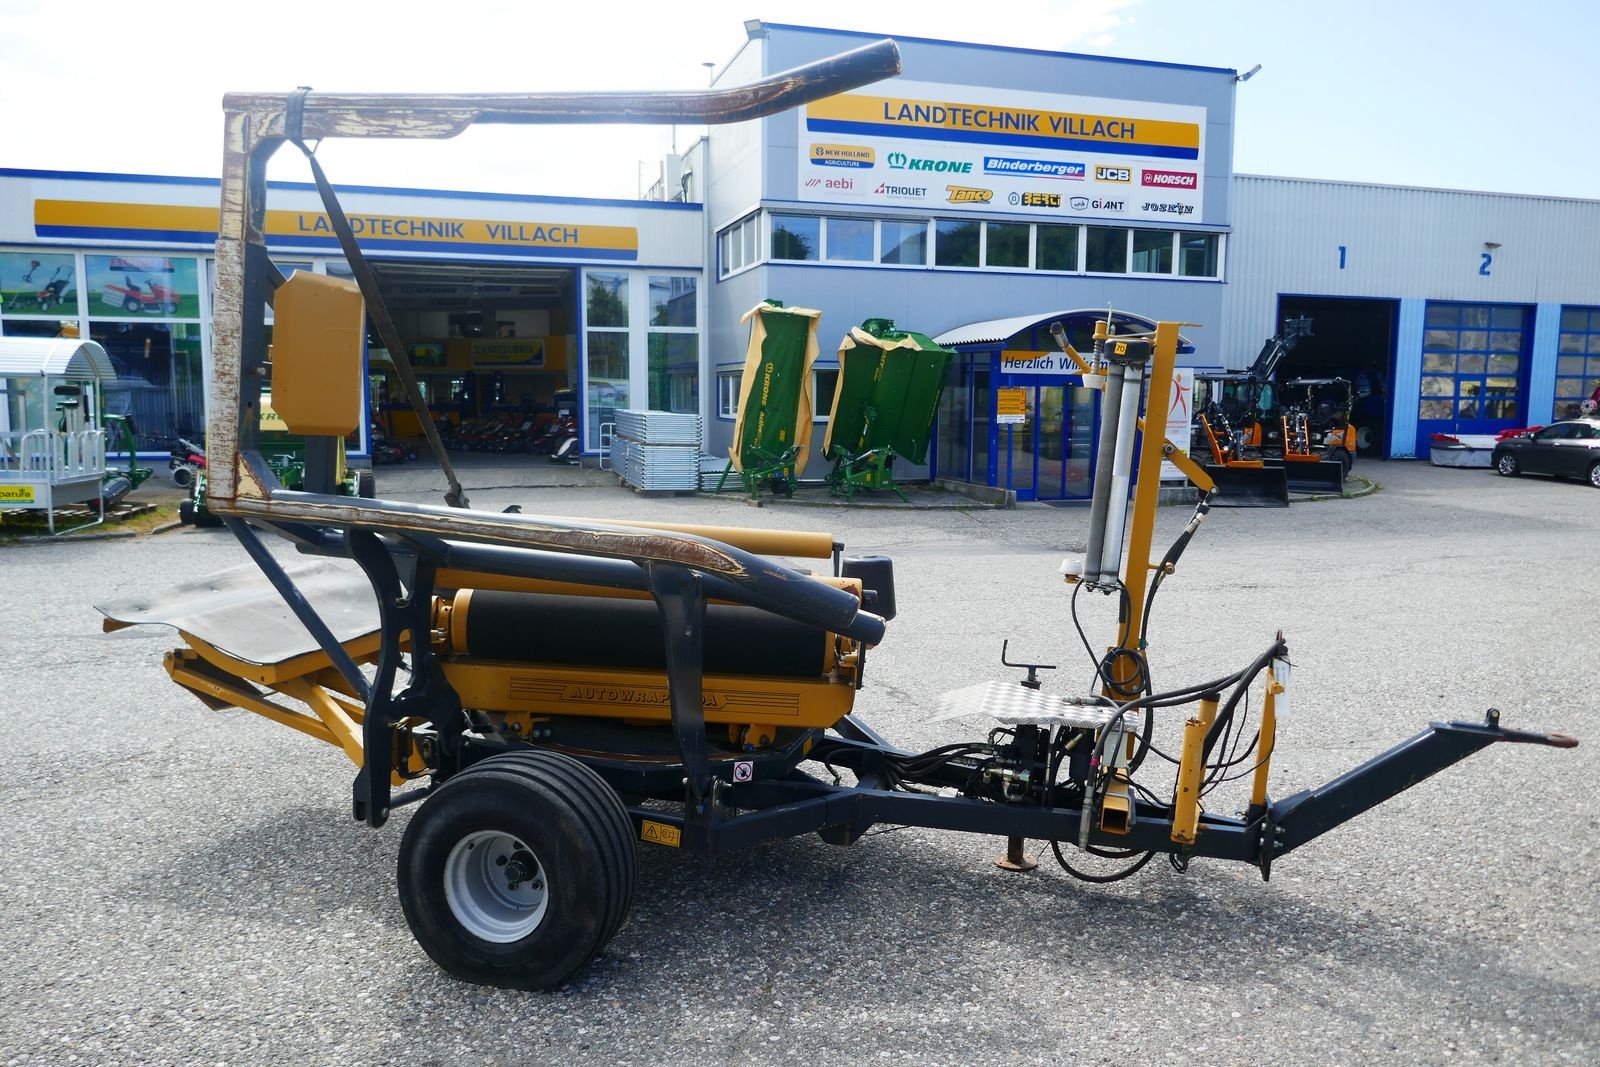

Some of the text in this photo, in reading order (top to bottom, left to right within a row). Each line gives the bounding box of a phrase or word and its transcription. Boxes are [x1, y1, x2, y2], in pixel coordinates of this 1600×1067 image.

[884, 102, 1135, 139] LANDTECHNIK VILLACH
[841, 150, 870, 158] HOLLAND
[824, 159, 860, 167] AGRICULTURE
[908, 158, 973, 173] KRONE
[987, 158, 1083, 176] Binderberger
[1097, 167, 1131, 181] JCB
[1153, 173, 1194, 186] HORSCH
[825, 178, 853, 190] aebi
[946, 186, 993, 203] Tanco
[299, 215, 579, 243] LADTECHNIK VILLACH
[1338, 246, 1346, 269] 1
[1479, 253, 1492, 276] 2
[1115, 344, 1125, 353] 70
[1004, 356, 1054, 370] Herzlich
[761, 373, 771, 406] KRONE
[571, 686, 671, 704] AUTOWRAP
